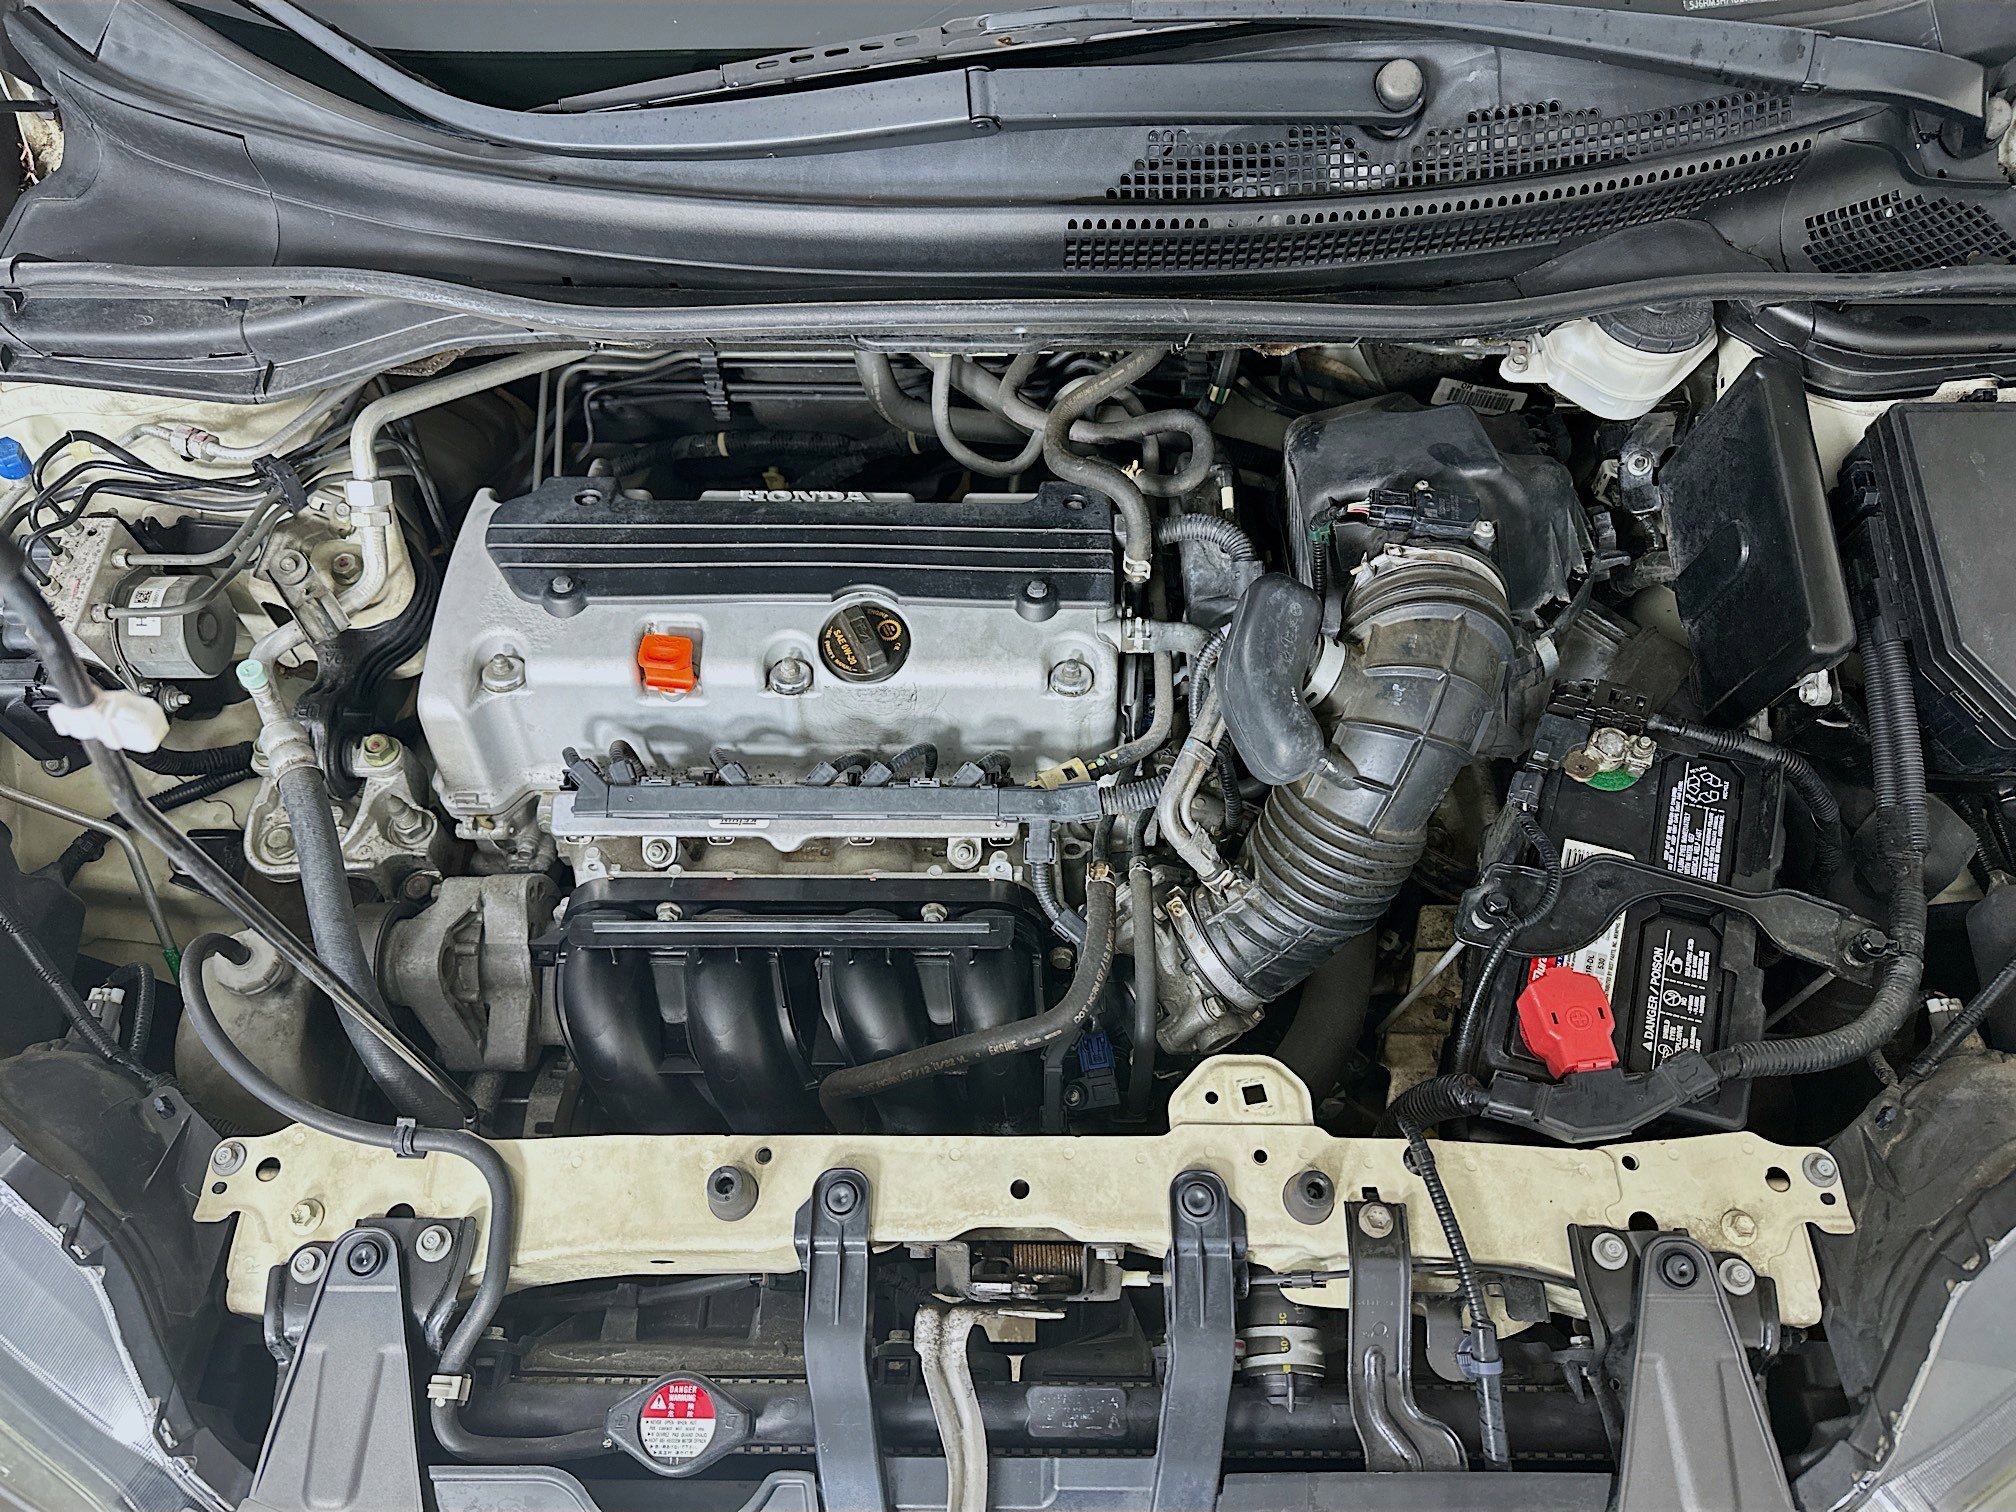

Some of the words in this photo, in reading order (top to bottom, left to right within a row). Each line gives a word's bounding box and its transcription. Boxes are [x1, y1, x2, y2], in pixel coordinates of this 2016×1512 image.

[739, 489, 871, 502] HONDA
[833, 629, 847, 645] SAE
[841, 644, 857, 665] 0W-20
[1585, 955, 1594, 975] 1R-DL
[1650, 947, 1664, 986] POISON
[1074, 1004, 1089, 1024] DOT
[1644, 995, 1658, 1039] DANGER
[1662, 1019, 1670, 1039] SHIELD
[988, 1040, 1019, 1056] ENGINE
[668, 1394, 696, 1402] WARNING
[669, 1385, 698, 1393] DANGER
